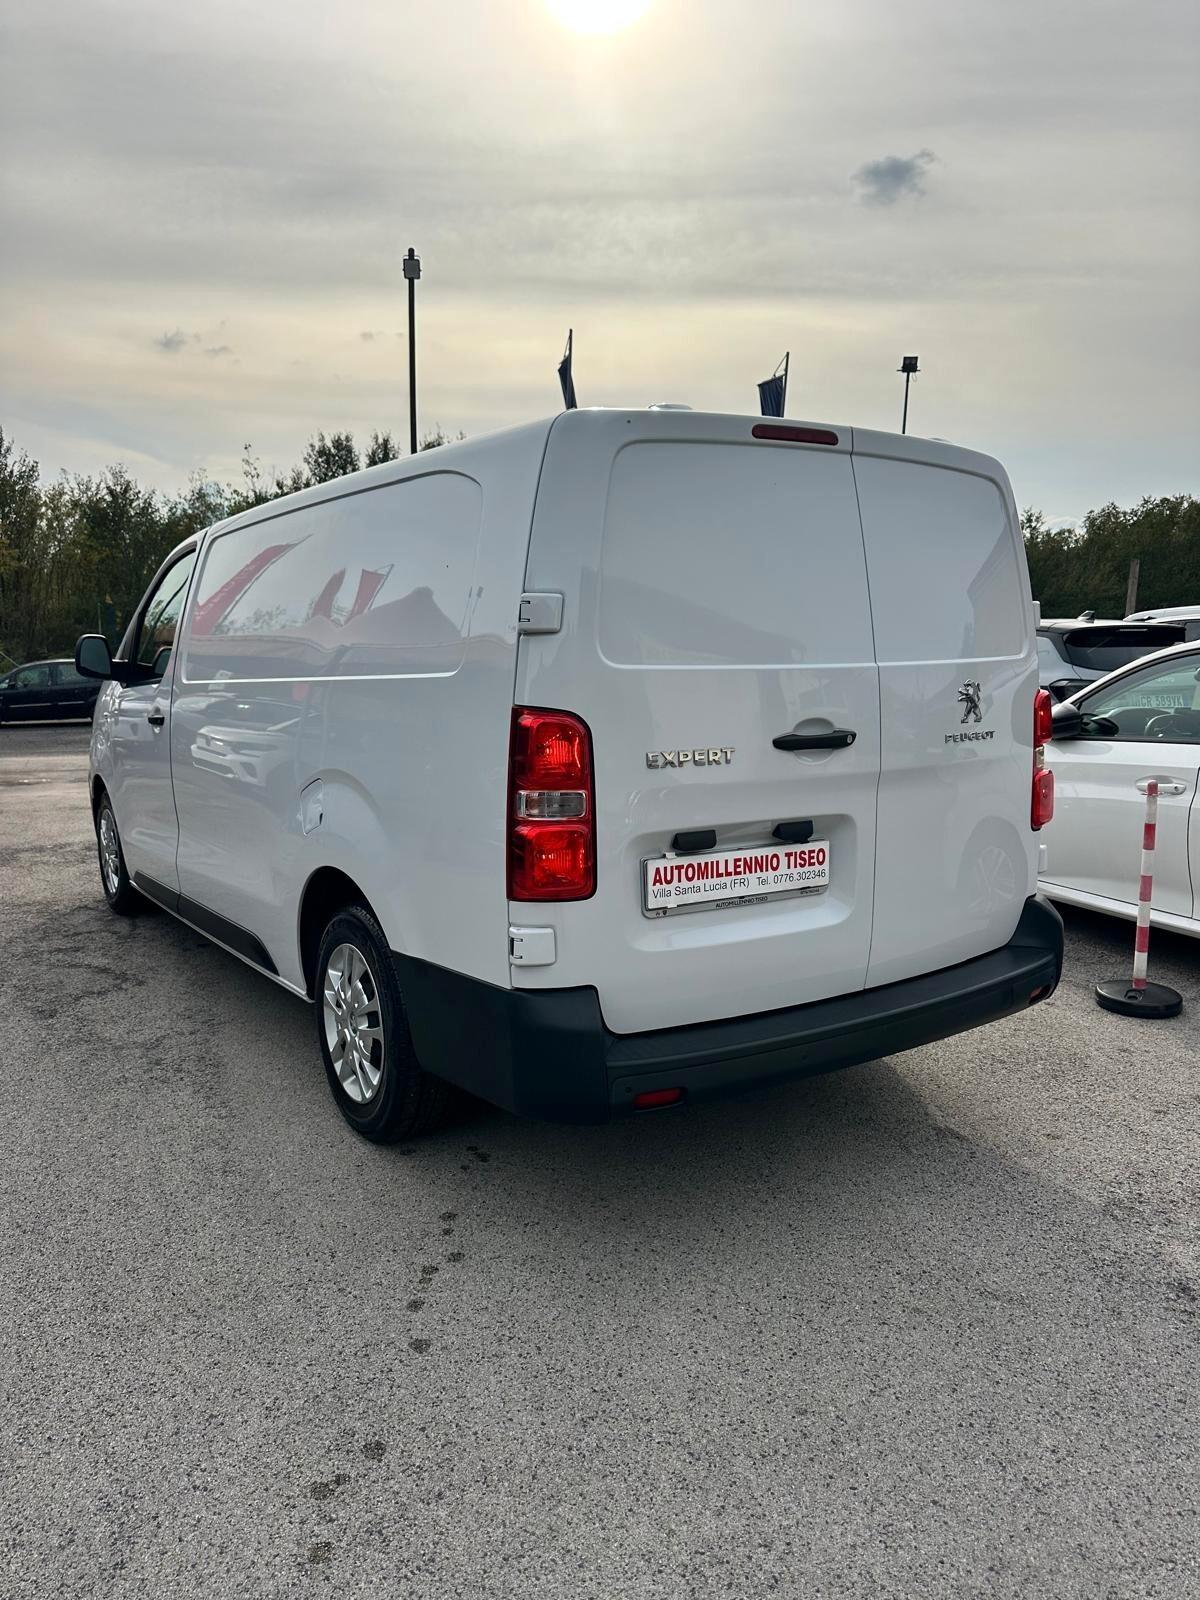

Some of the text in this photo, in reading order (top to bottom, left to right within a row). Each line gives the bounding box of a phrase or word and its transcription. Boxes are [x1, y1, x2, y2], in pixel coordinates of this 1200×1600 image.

[944, 730, 996, 744] PEUGEOT
[645, 746, 736, 769] EXPERT
[652, 847, 826, 887] AUTOMILLENNIO TISEO
[652, 868, 827, 899] Villa Santa Lucia (FR) Tel. 0776.302346
